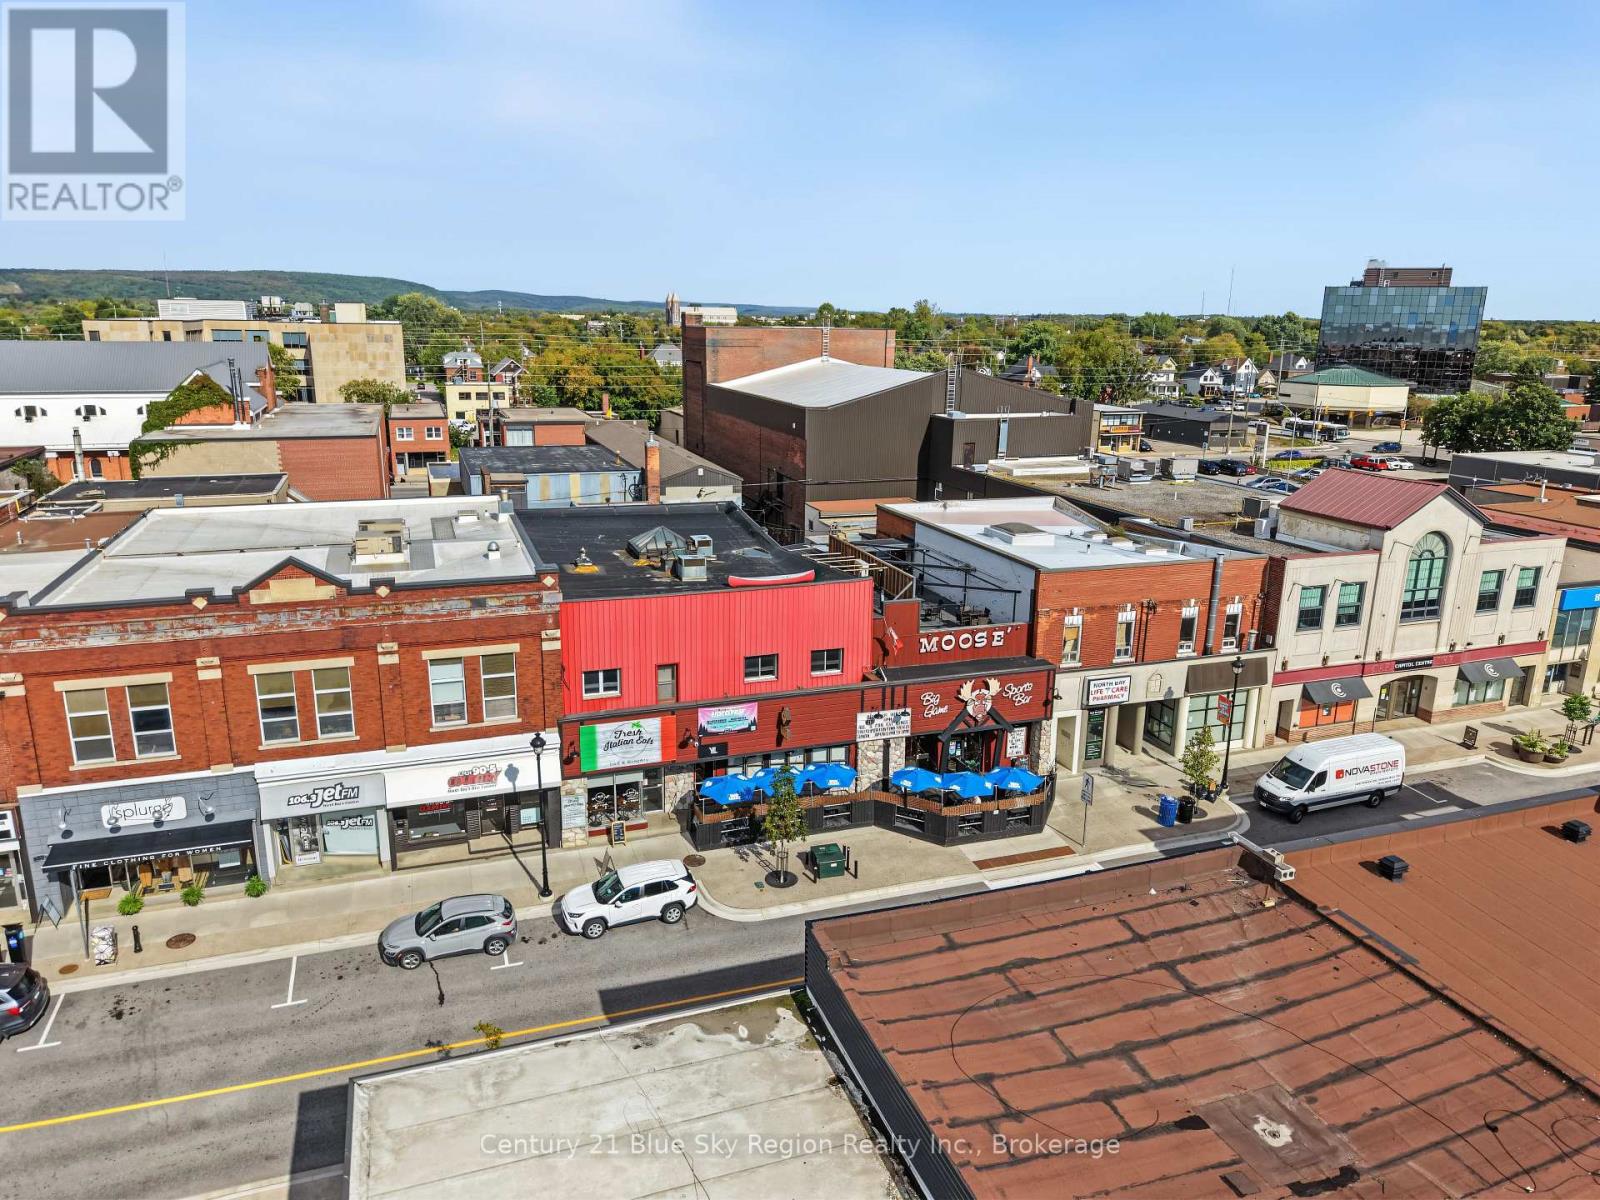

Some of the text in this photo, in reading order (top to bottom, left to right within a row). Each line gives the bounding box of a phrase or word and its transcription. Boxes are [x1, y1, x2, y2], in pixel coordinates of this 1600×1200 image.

[1002, 683, 1033, 698] Sports
[1090, 686, 1128, 696] LIFE CARE
[920, 692, 940, 706] Big
[1013, 694, 1033, 706] Bar
[1092, 694, 1125, 702] PHARMACY
[923, 705, 949, 718] Game
[614, 729, 642, 739] Fresh
[603, 736, 654, 751] Italian Eats
[1344, 759, 1399, 776] NOVASTONE
[72, 862, 97, 870] FINE
[103, 855, 155, 866] CLOTHING
[186, 846, 222, 855] WOMEN
